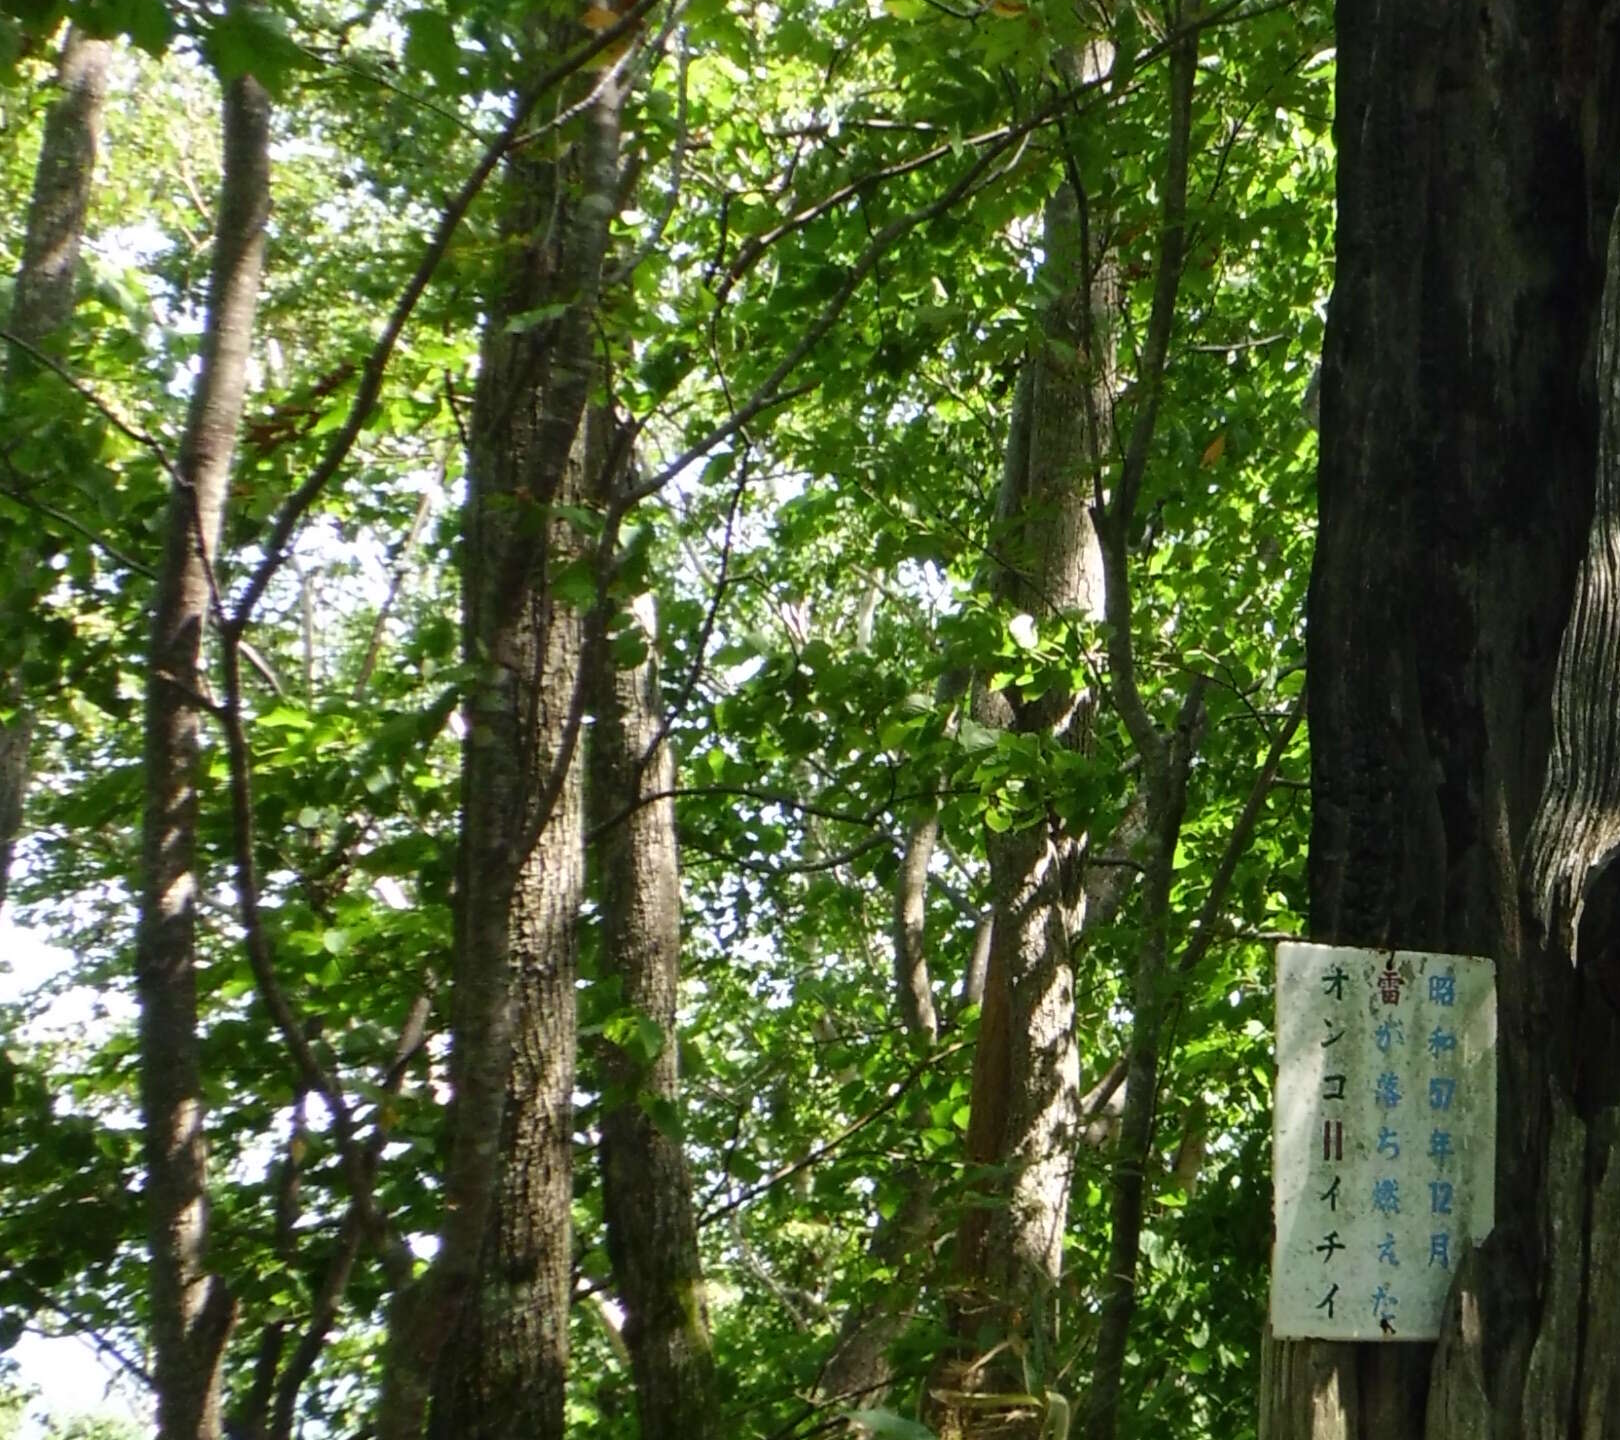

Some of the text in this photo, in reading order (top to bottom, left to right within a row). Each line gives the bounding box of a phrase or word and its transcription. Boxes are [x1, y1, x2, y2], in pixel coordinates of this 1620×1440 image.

[1371, 970, 1404, 1320] 雷が落ち燃えた
[1428, 975, 1457, 1269] 昭和57年12月
